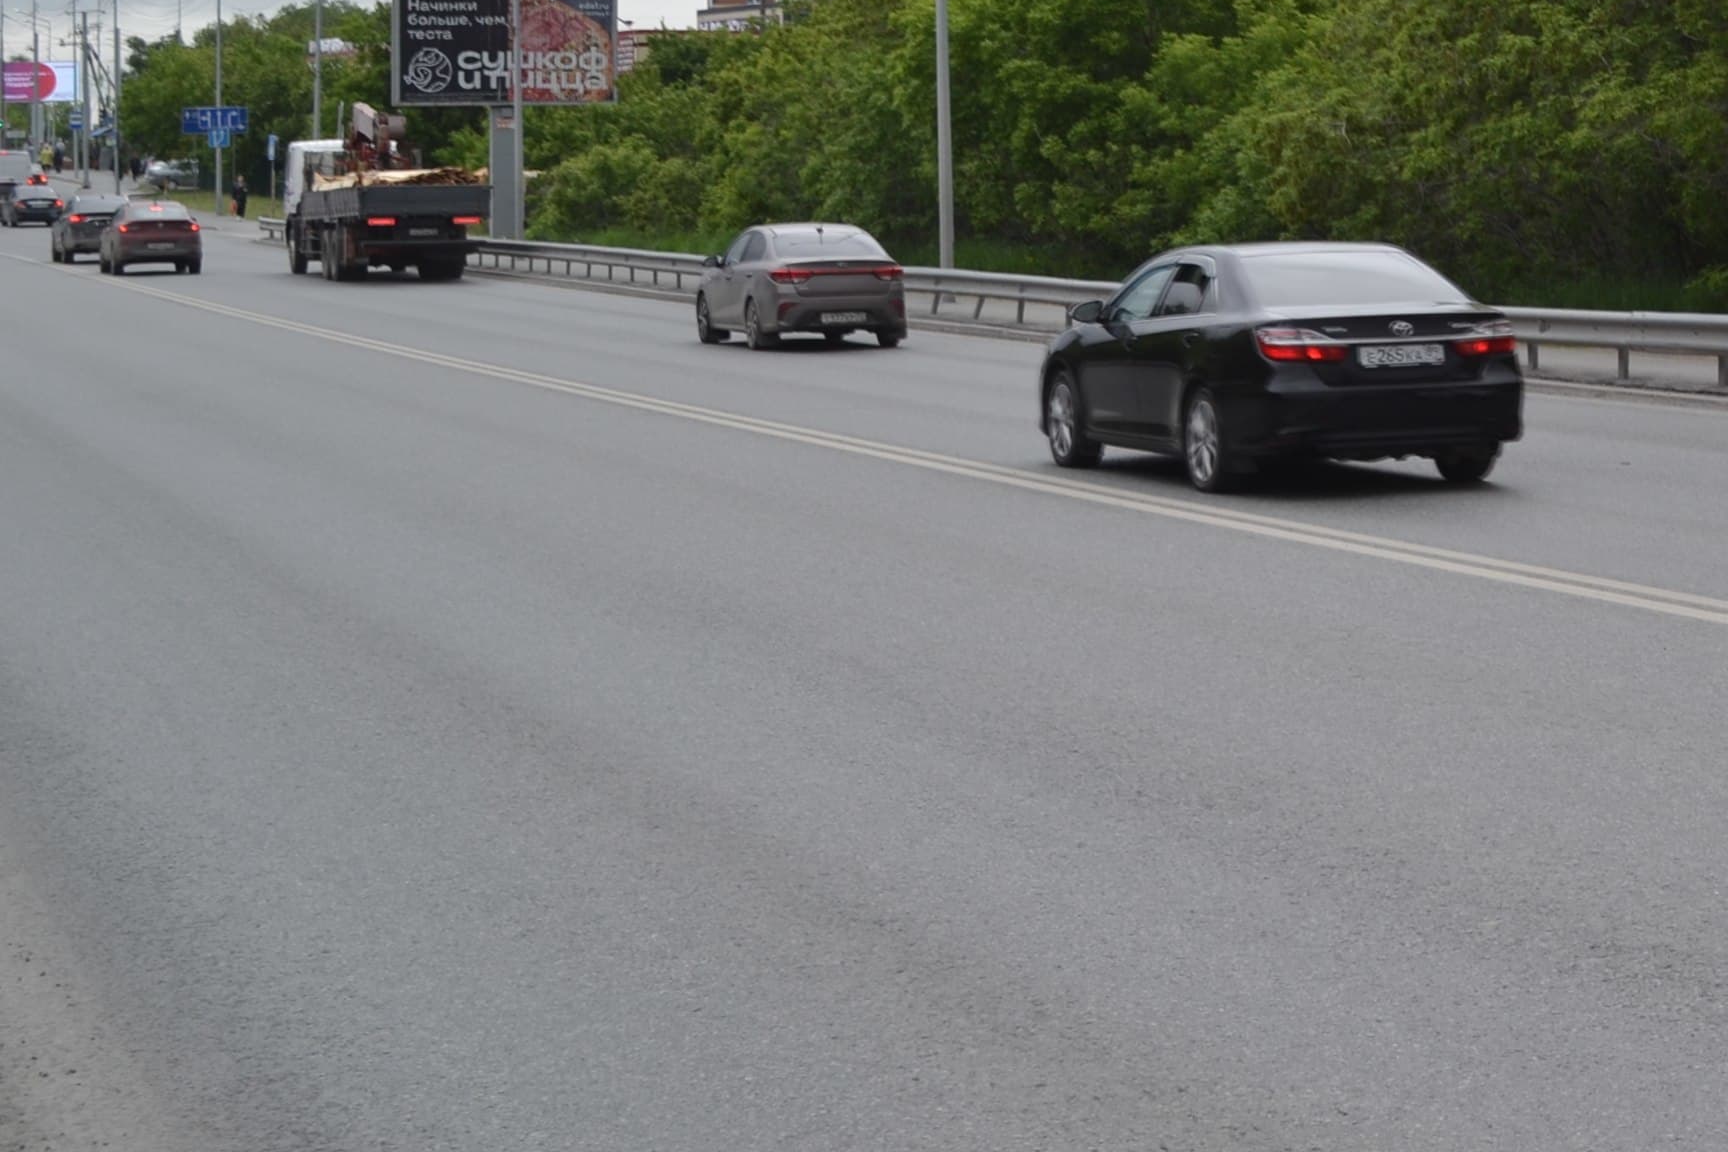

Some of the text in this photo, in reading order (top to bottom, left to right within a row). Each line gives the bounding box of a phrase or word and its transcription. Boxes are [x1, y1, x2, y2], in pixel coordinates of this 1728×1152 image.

[407, 13, 507, 27] больше, чем
[407, 29, 454, 41] теста
